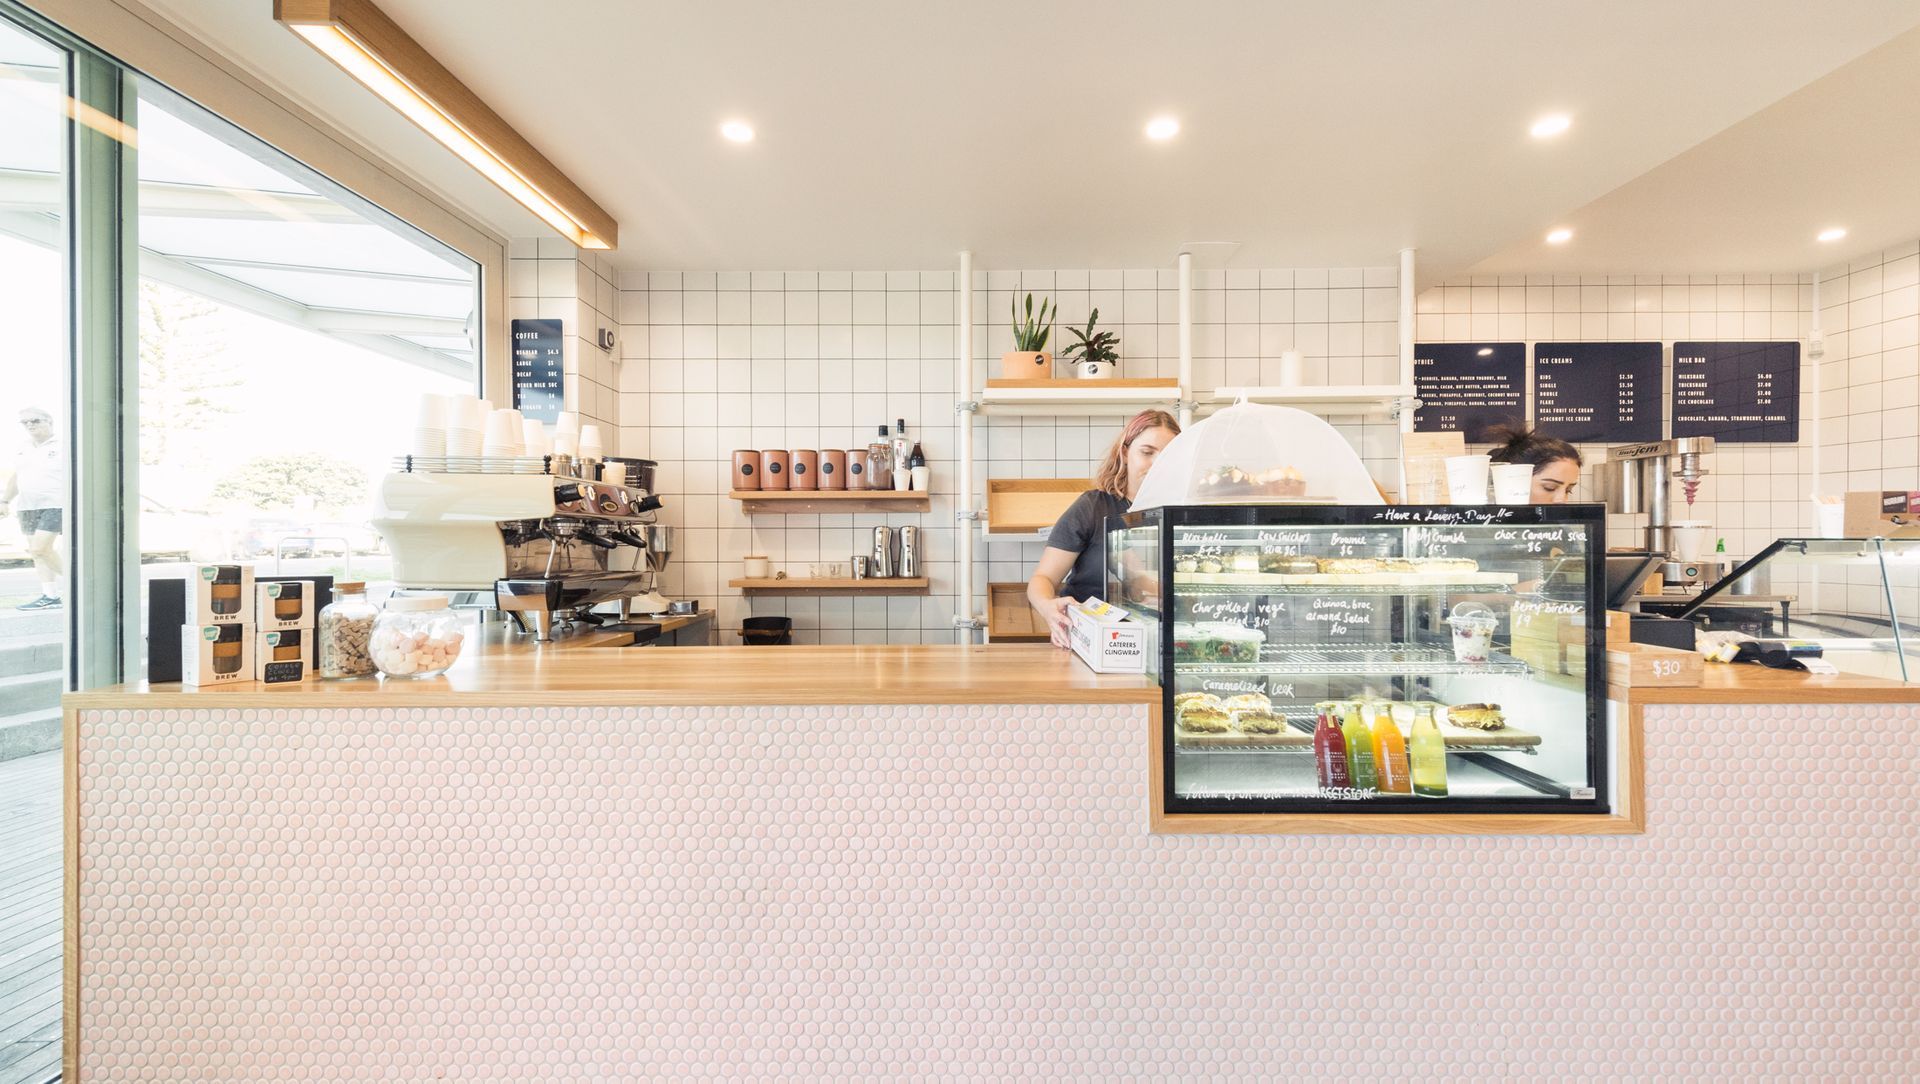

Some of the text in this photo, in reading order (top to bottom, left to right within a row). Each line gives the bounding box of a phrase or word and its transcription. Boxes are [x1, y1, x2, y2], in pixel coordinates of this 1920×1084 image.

[515, 332, 538, 340] COFFEE
[1385, 508, 1410, 521] Have
[1413, 512, 1421, 521] a
[1340, 545, 1353, 557] $6
[1527, 541, 1542, 553] $6
[1254, 616, 1270, 630] $10
[1330, 621, 1347, 636] $10
[1652, 660, 1681, 680] $30
[215, 673, 239, 681] BREW
